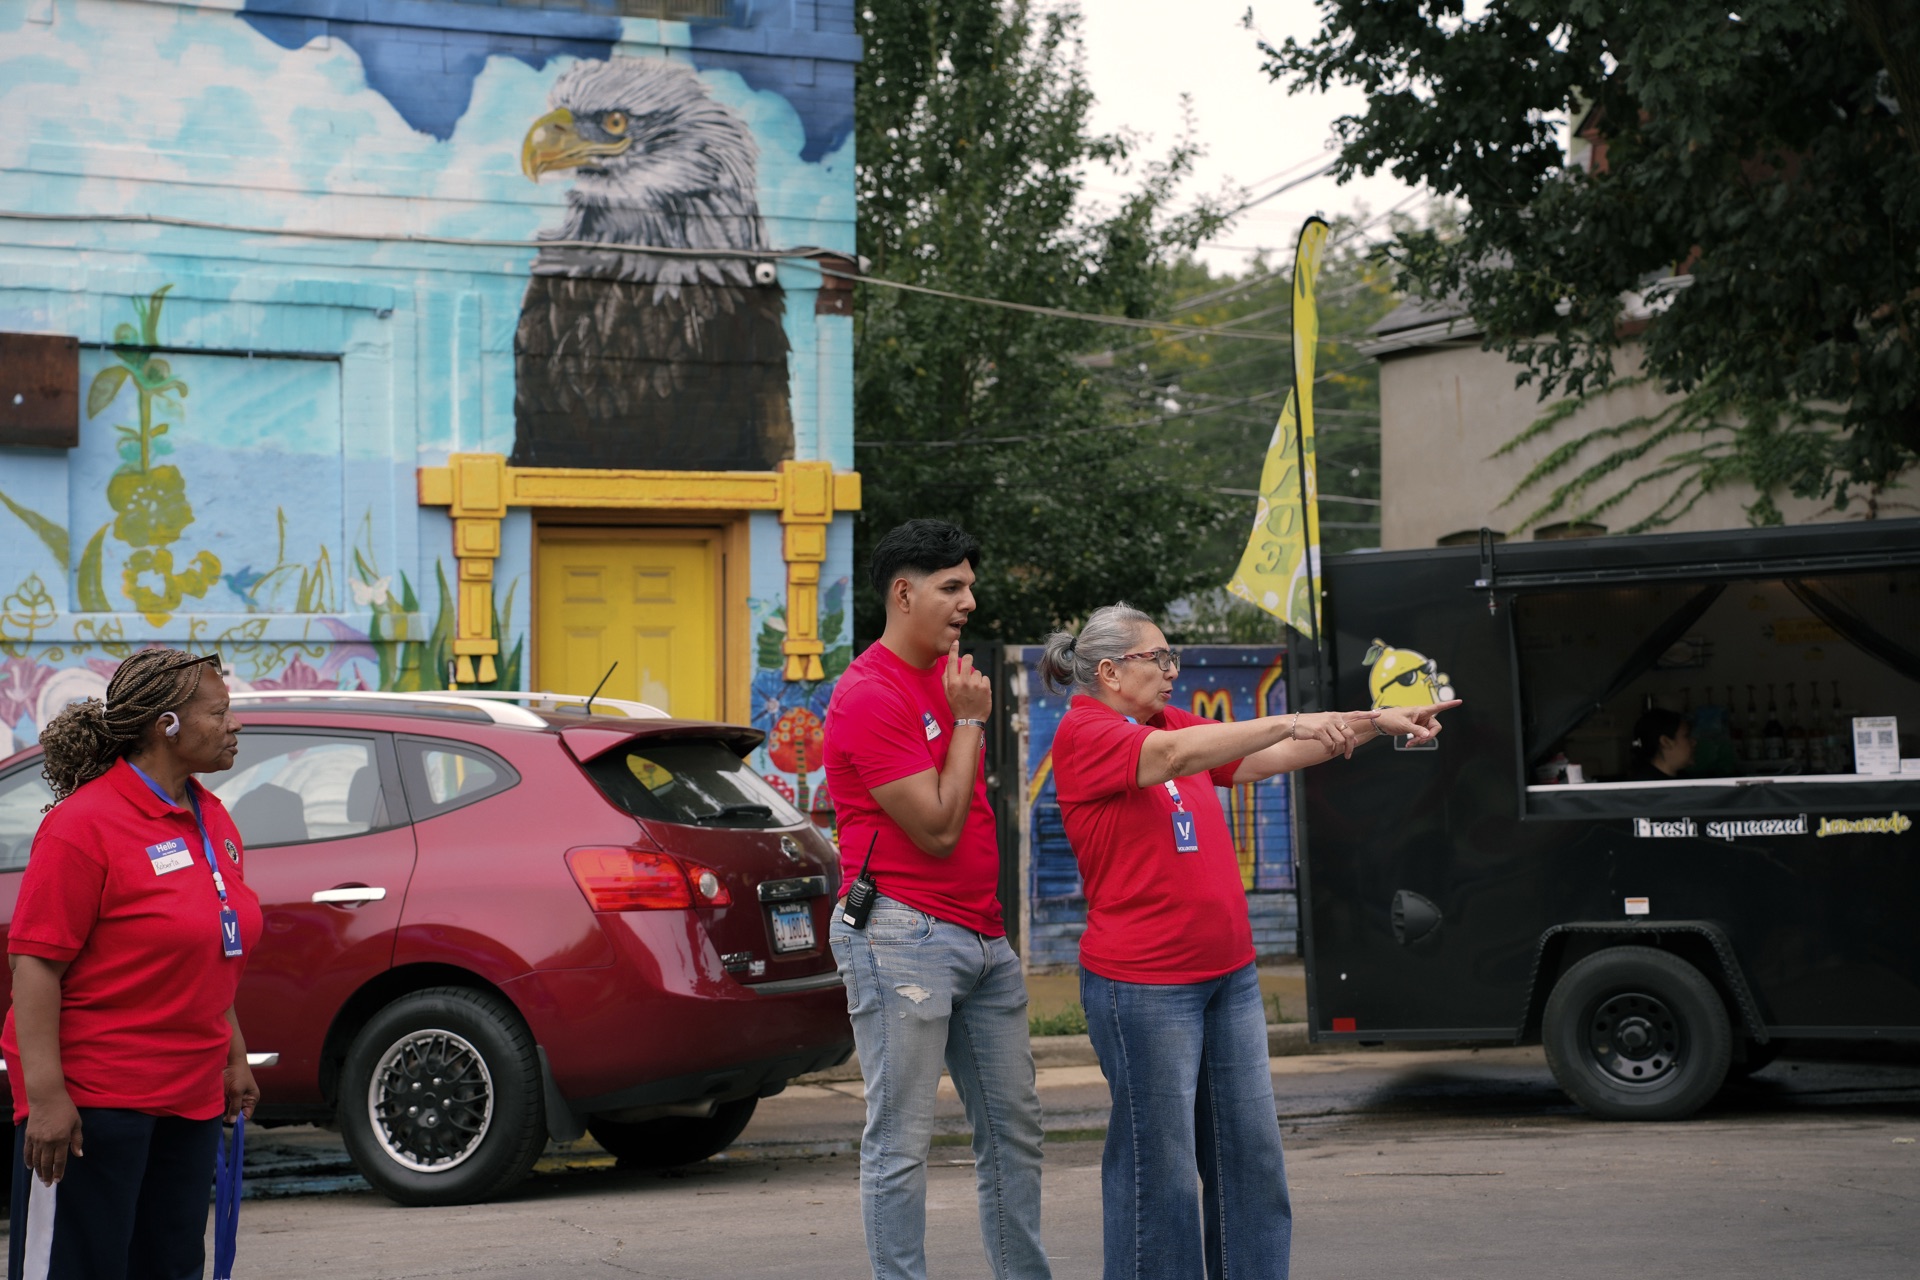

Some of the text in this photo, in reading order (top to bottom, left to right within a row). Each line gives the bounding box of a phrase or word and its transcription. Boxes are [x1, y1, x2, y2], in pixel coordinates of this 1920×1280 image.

[1633, 811, 1912, 841] Fresh squeezed Lemonade
[156, 841, 177, 853] Hello
